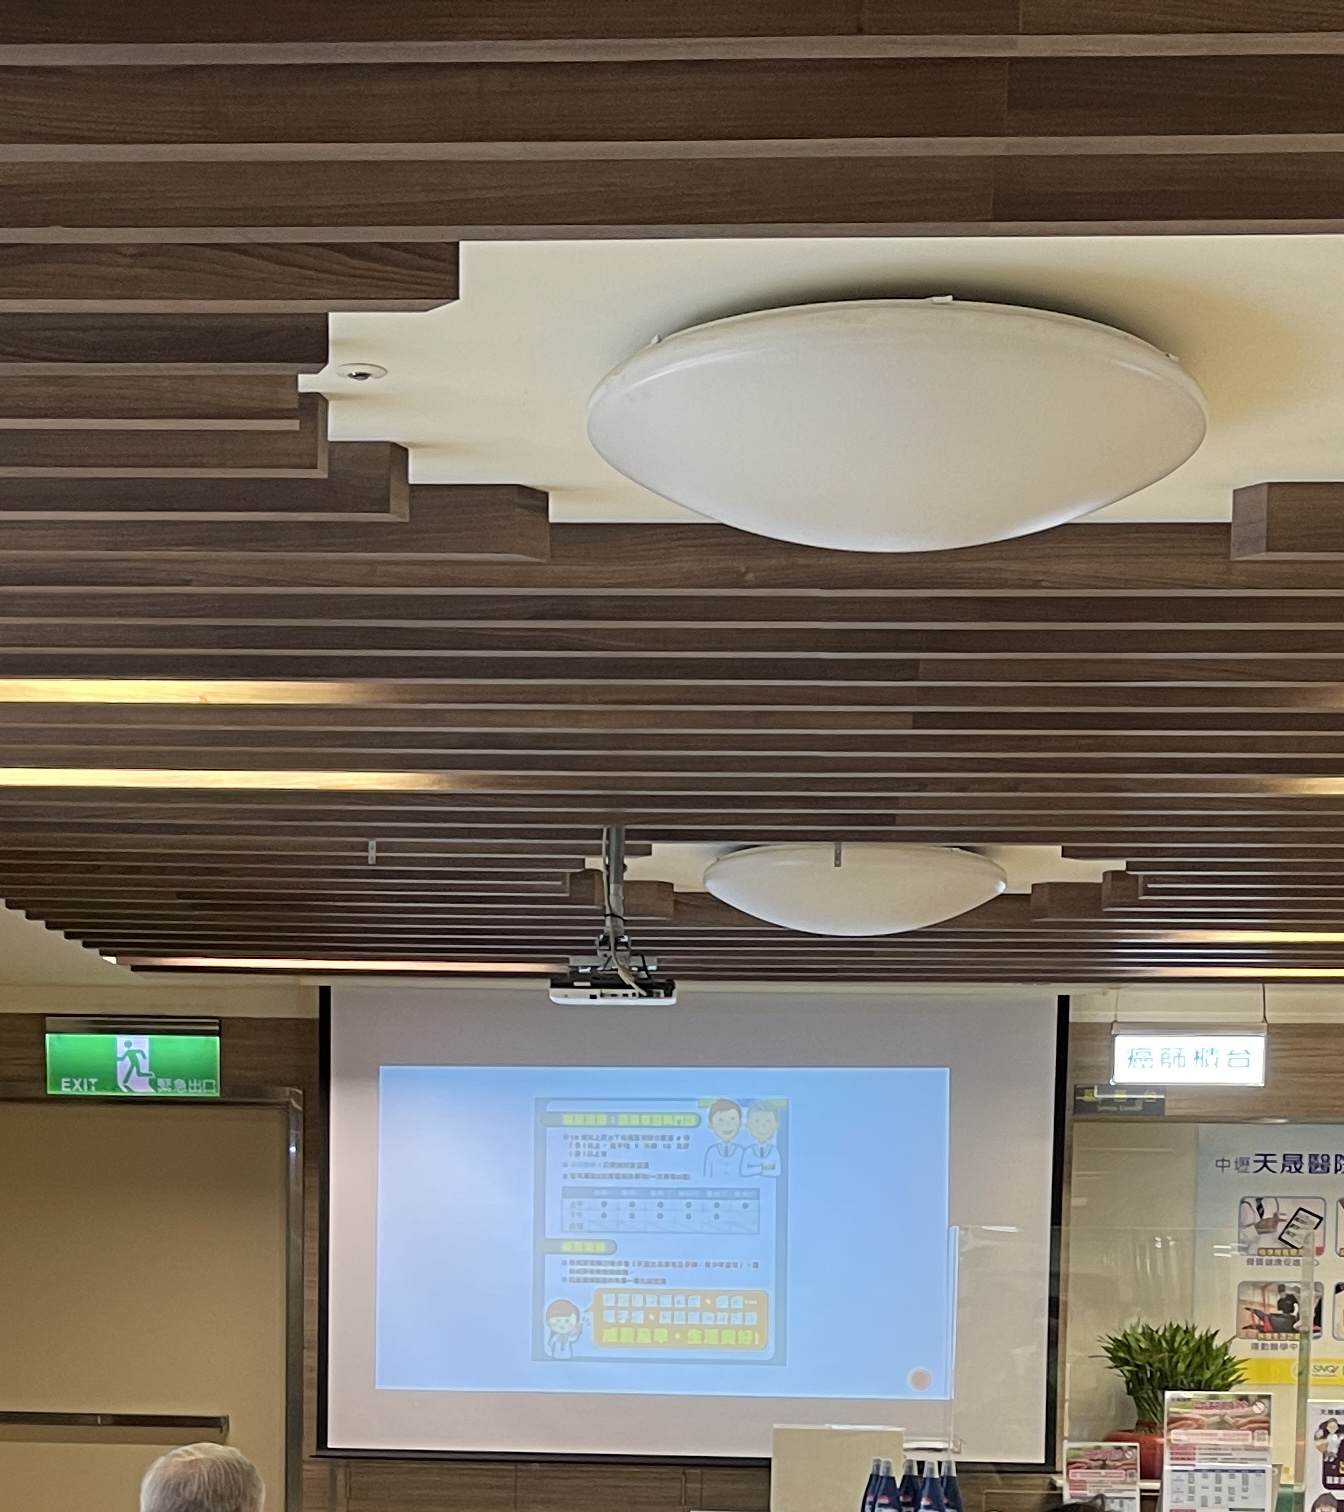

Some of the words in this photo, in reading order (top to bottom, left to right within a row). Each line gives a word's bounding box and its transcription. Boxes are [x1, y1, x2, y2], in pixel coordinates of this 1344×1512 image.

[60, 1077, 99, 1092] EXIT
[157, 1077, 217, 1094] 緊急出口
